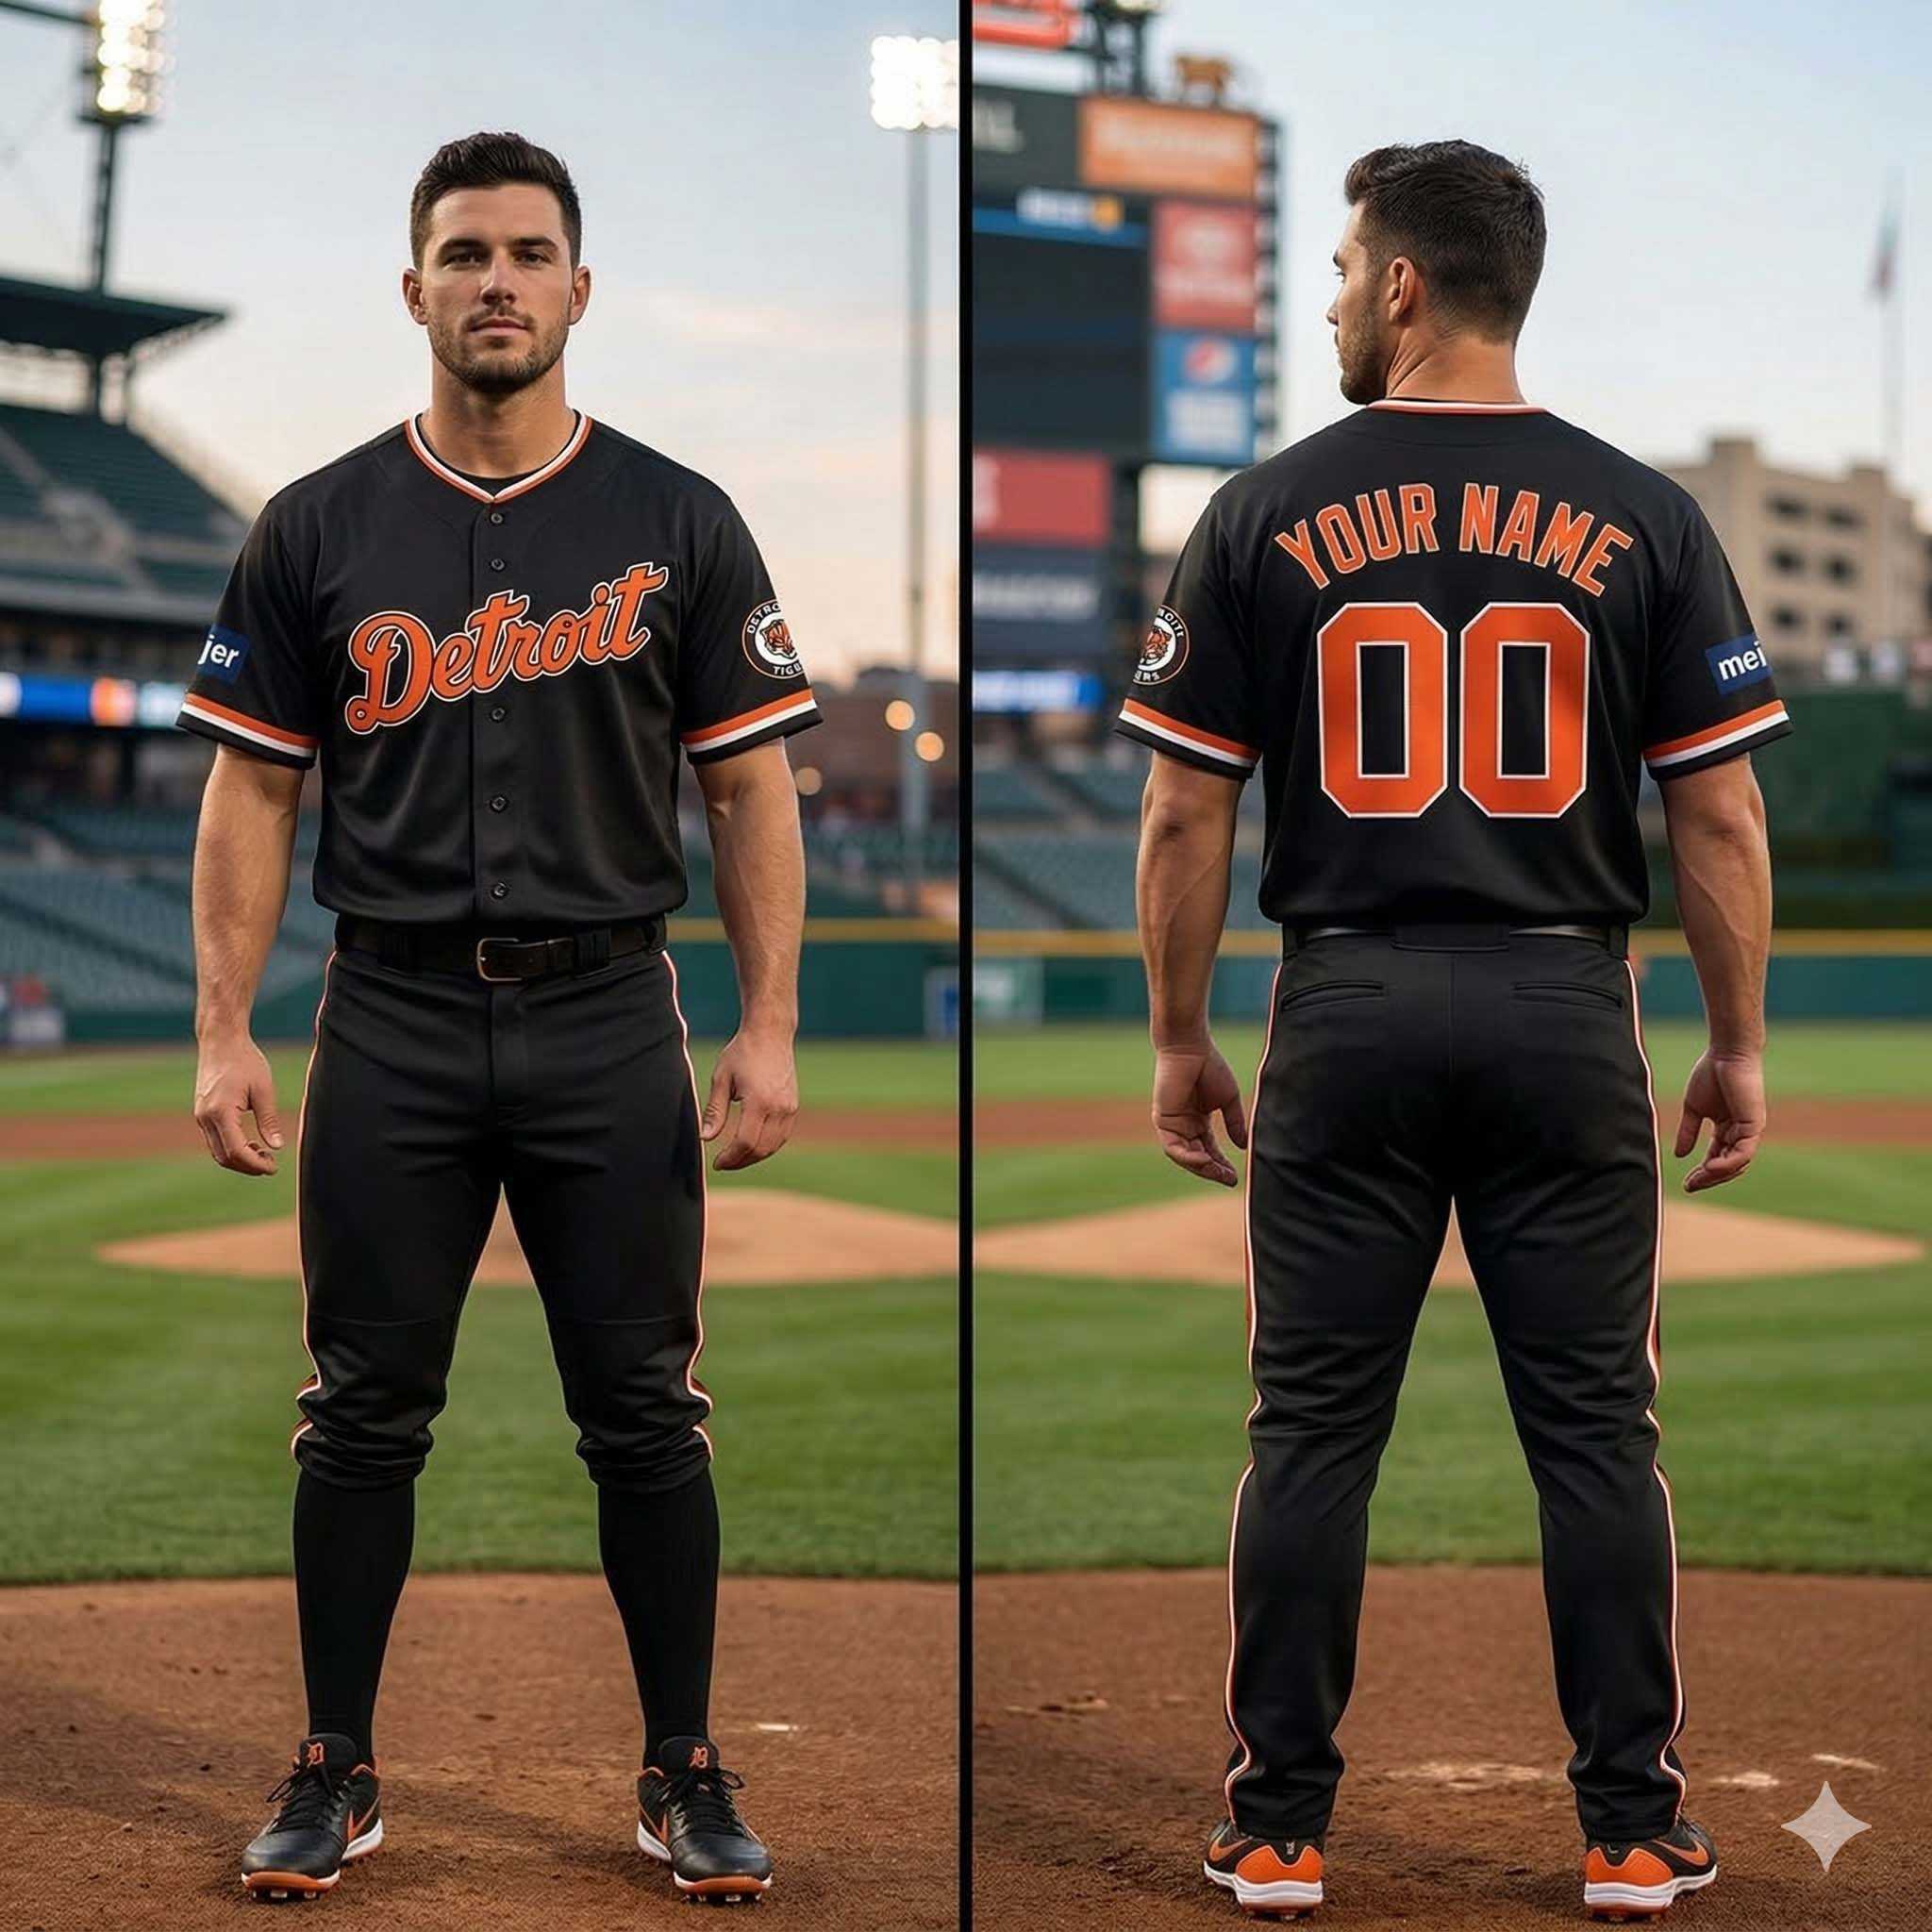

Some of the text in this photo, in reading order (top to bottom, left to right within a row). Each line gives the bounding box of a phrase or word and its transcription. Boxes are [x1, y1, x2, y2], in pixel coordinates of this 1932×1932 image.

[1274, 482, 1635, 598] YOUR NAME
[197, 633, 241, 669] jer
[344, 561, 669, 735] Detroit
[1717, 640, 1768, 681] mei
[1316, 601, 1591, 819] 00
